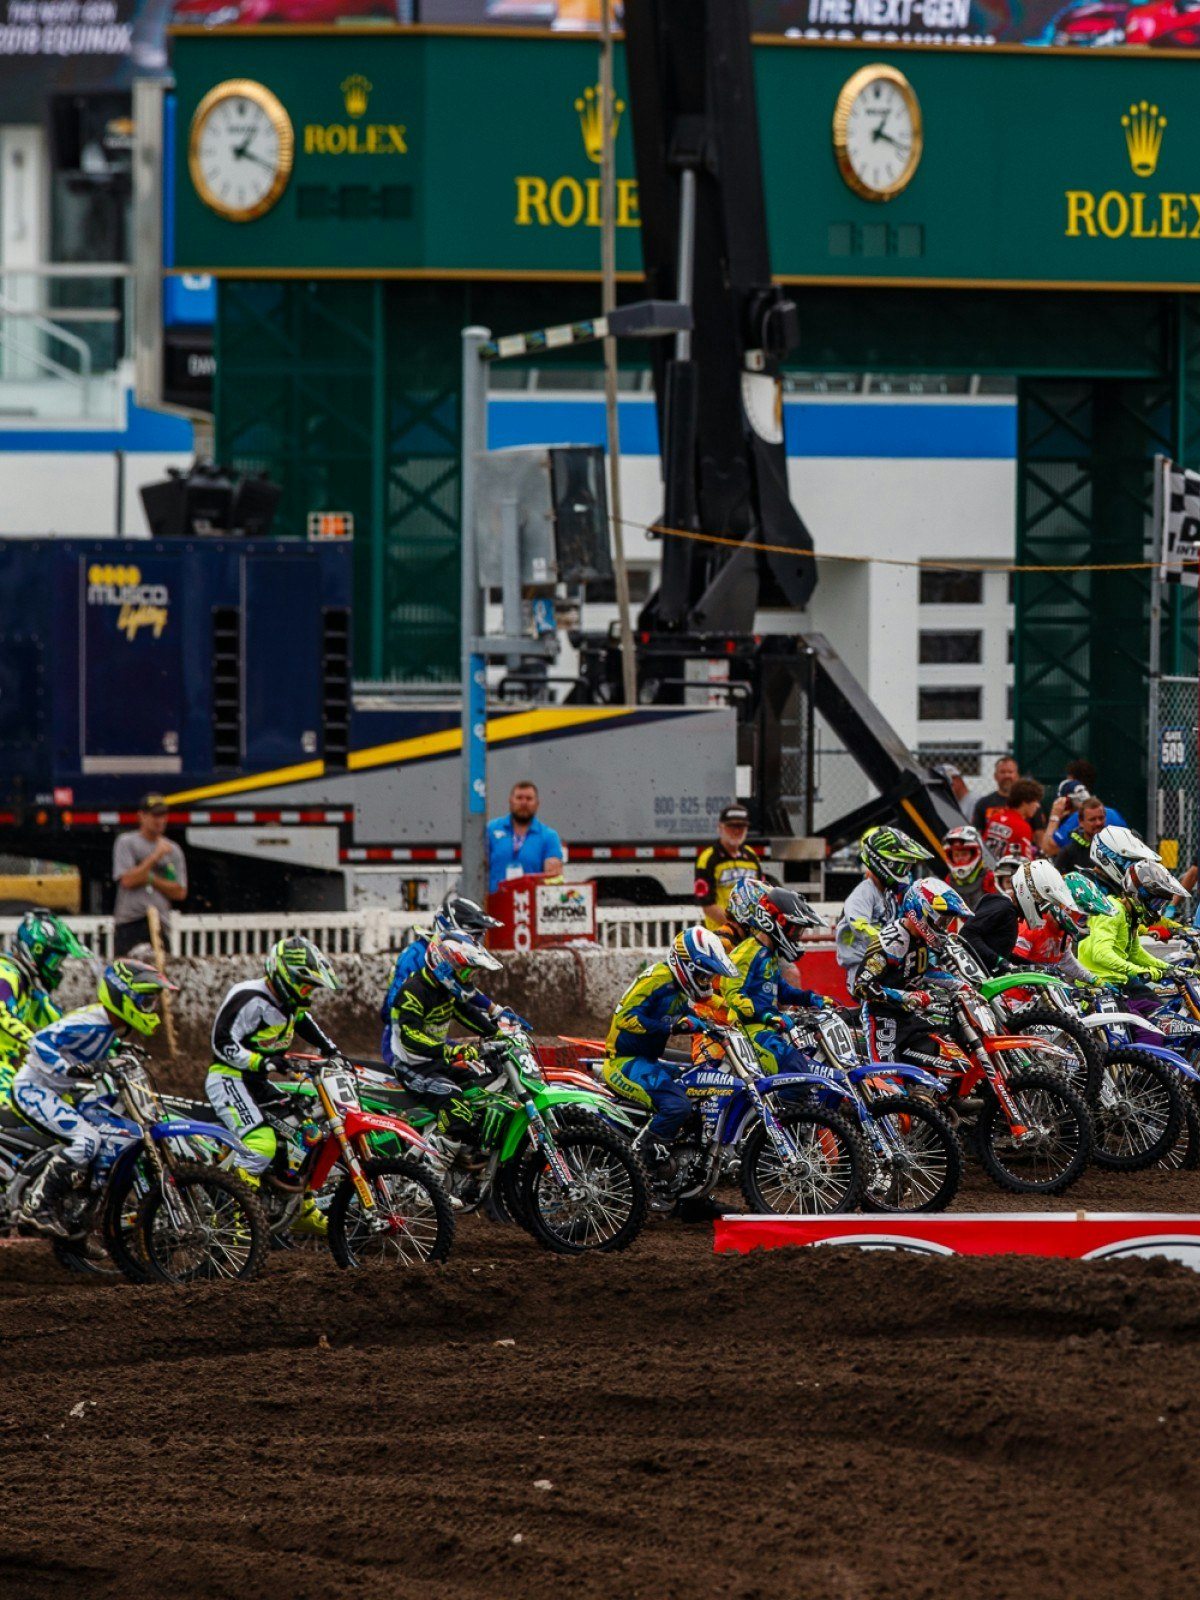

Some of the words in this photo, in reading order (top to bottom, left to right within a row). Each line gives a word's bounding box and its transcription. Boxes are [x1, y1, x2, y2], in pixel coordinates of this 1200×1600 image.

[807, 0, 851, 24] THE
[303, 124, 408, 155] ROLEX
[514, 176, 640, 227] ROLE
[1162, 742, 1185, 764] 509
[826, 1025, 849, 1055] 19
[609, 1072, 639, 1094] thor
[696, 1072, 734, 1086] YAMAHA
[997, 1084, 1022, 1121] DUNLOP
